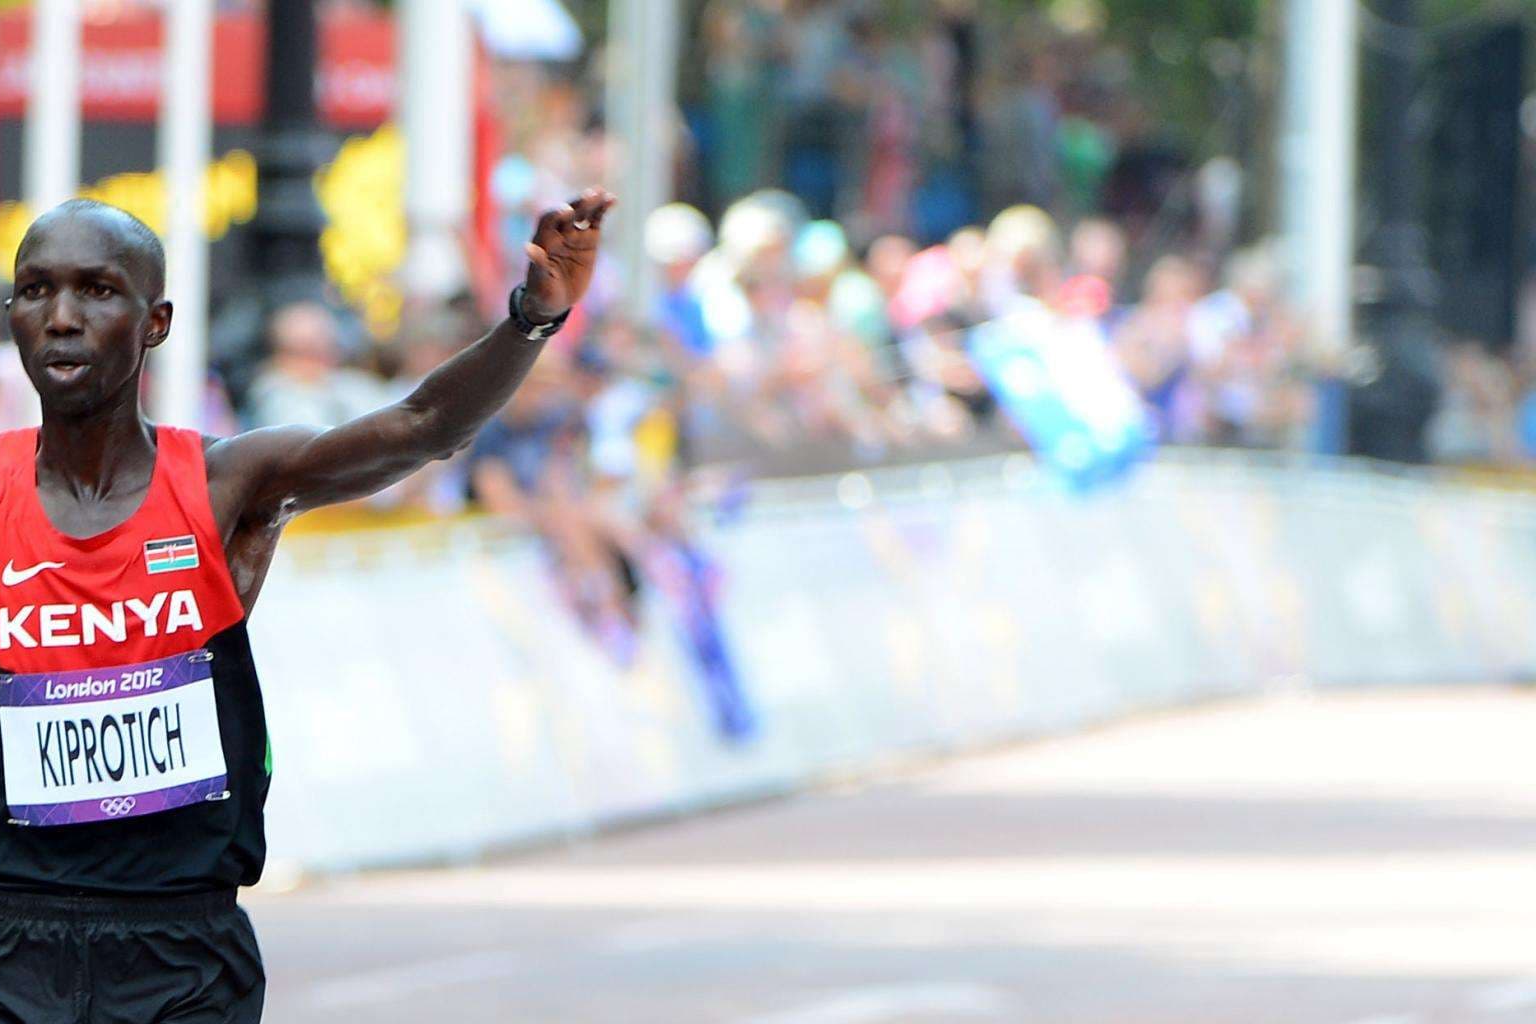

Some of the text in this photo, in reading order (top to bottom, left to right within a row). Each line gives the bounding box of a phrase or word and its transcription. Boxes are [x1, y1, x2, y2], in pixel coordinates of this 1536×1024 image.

[45, 667, 164, 700] London 2012
[36, 702, 186, 788] KIPROTICH
